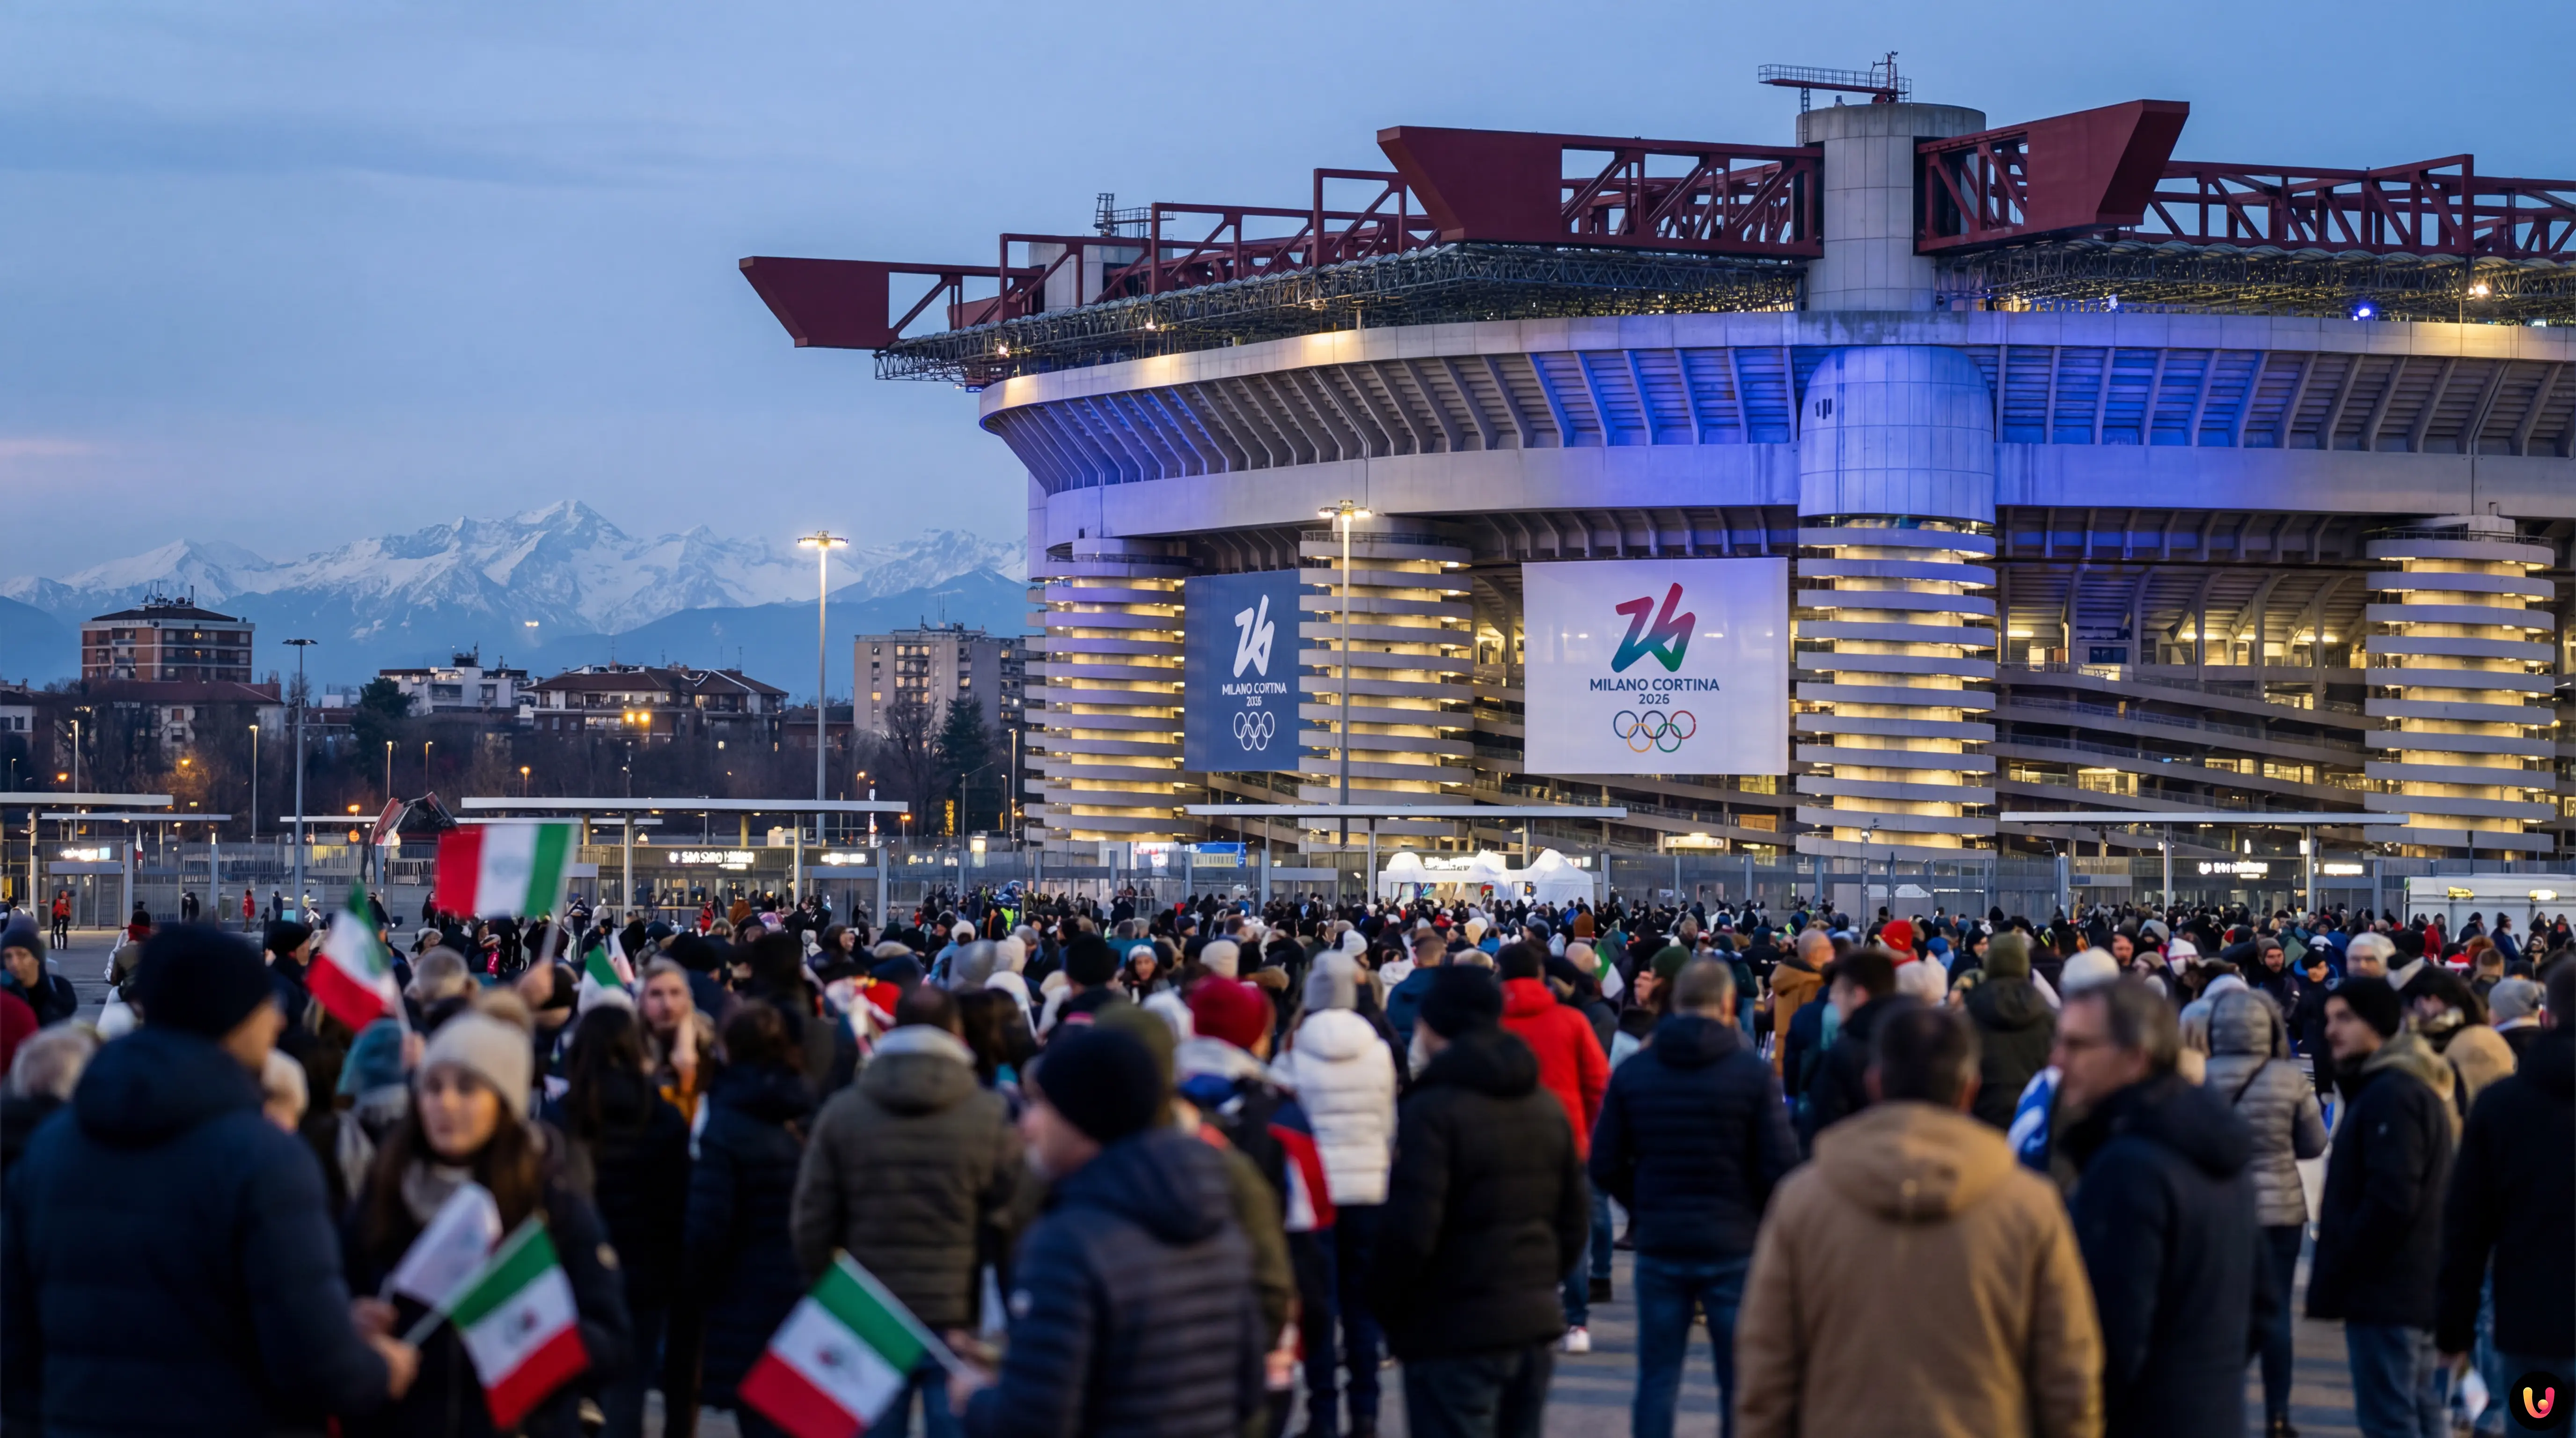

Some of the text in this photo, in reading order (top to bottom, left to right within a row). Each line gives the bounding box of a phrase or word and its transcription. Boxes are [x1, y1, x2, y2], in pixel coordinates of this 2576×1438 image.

[1222, 683, 1252, 696] MILANO
[1590, 678, 1720, 691] MILANO CORTINA
[1639, 693, 1670, 704] 2026
